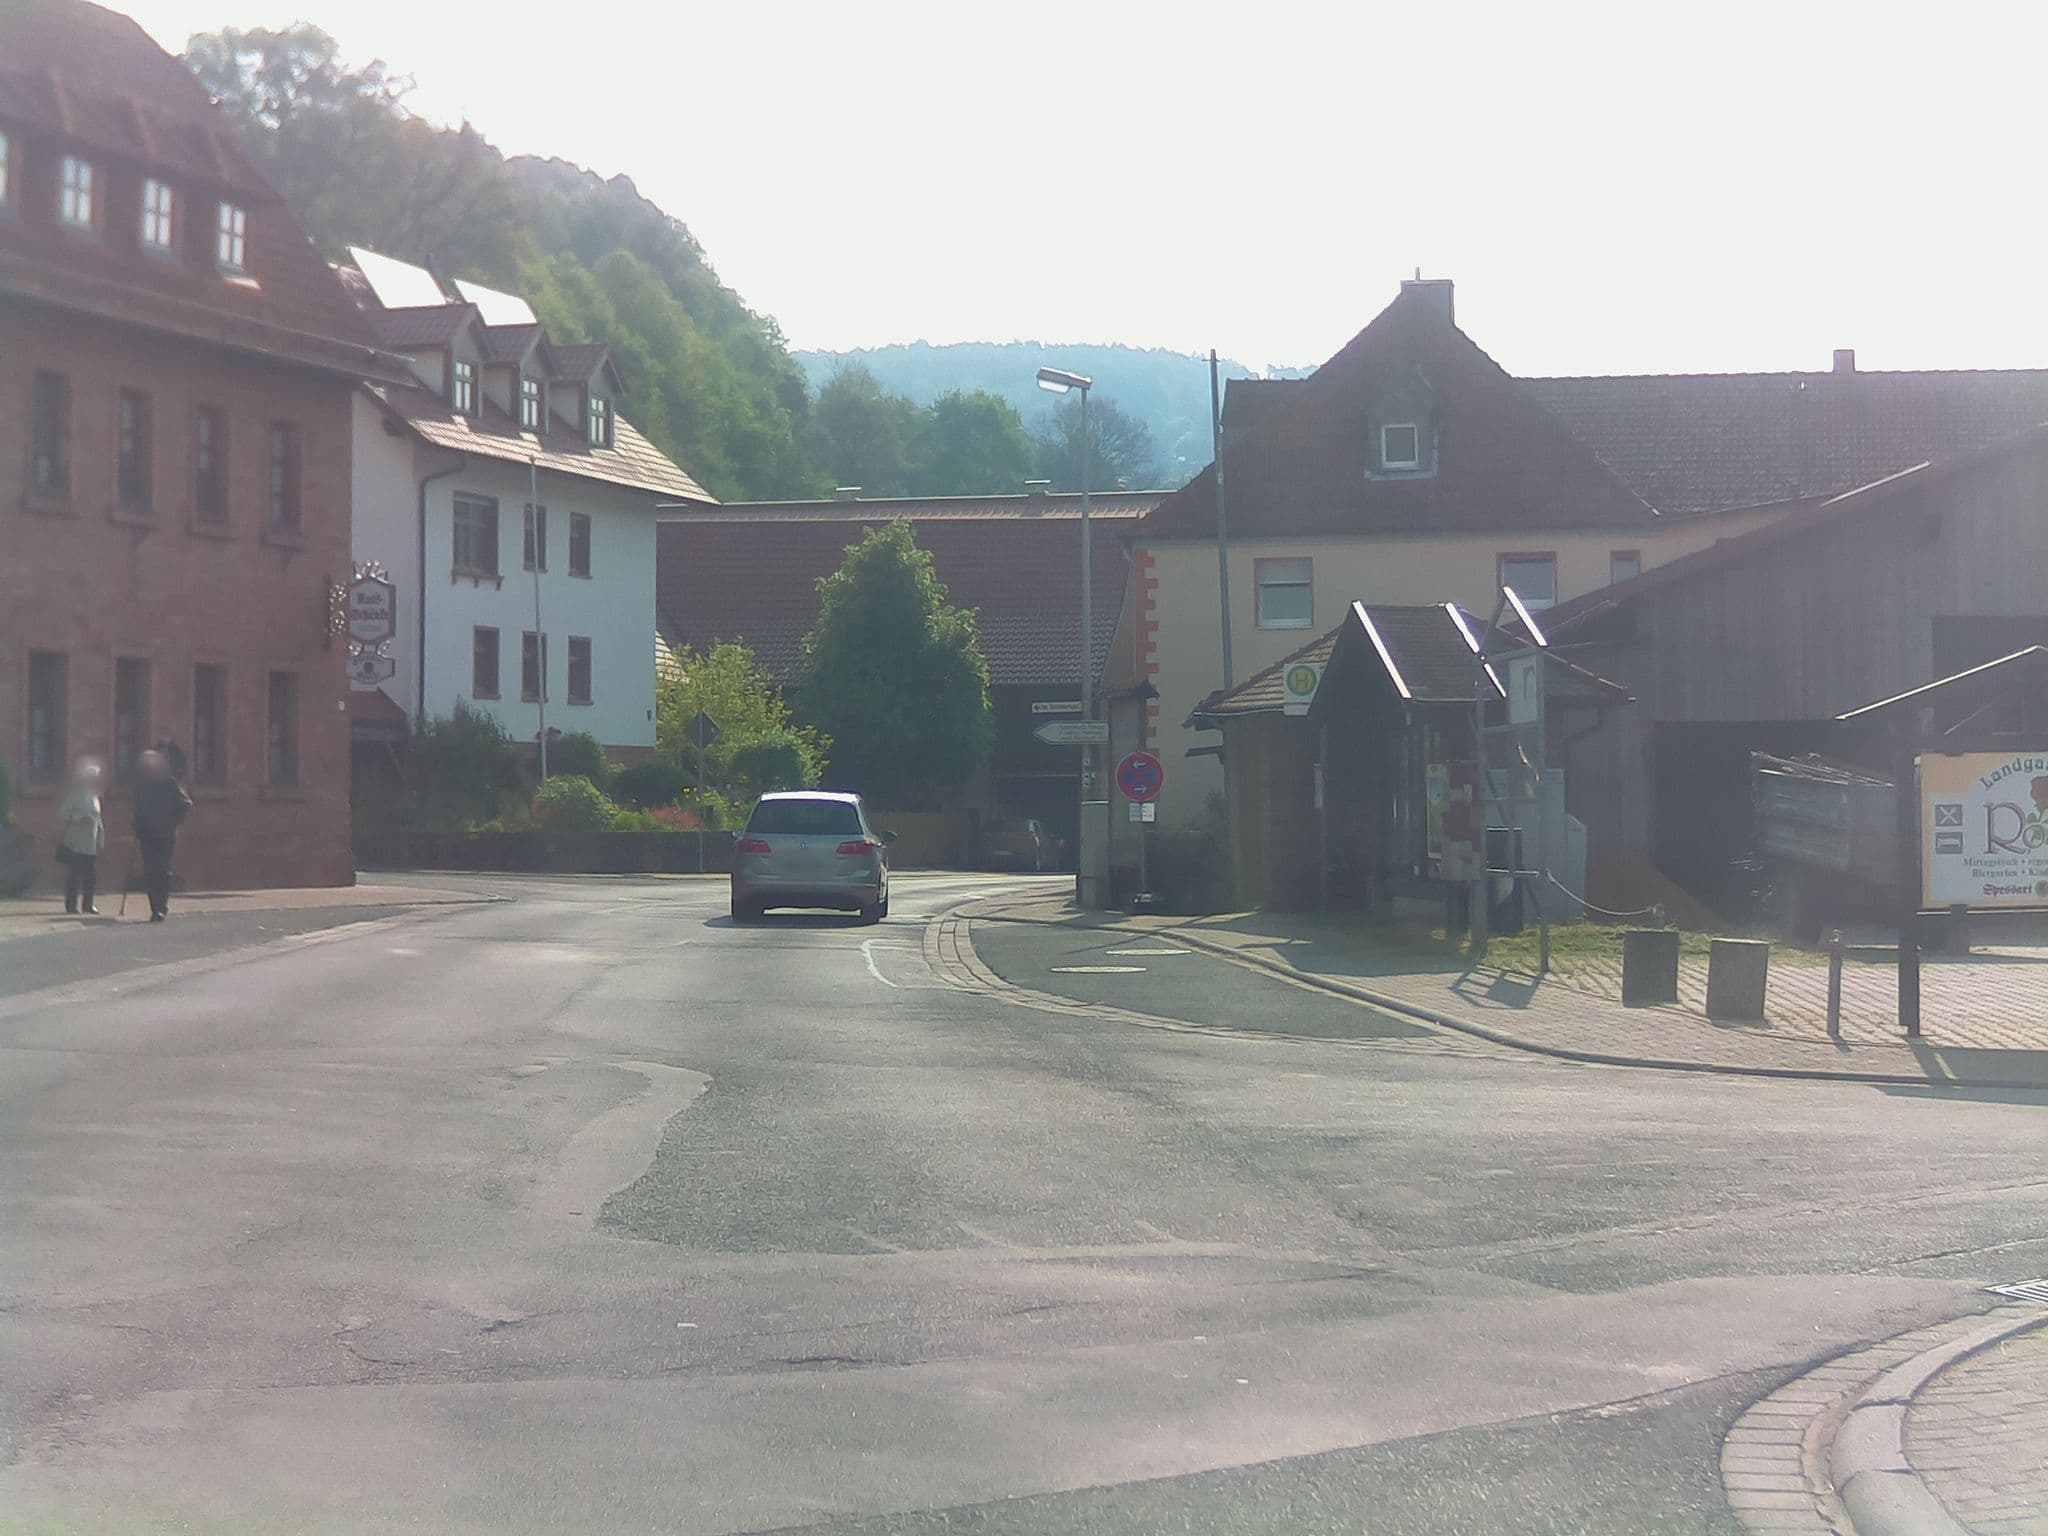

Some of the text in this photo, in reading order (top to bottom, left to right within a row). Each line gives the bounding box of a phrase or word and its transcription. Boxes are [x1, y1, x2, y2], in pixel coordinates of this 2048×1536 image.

[1295, 671, 1308, 689] H
[1983, 802, 2048, 855] Ro
[1972, 868, 2018, 877] Biergarten
[1983, 883, 2032, 896] Spessart
